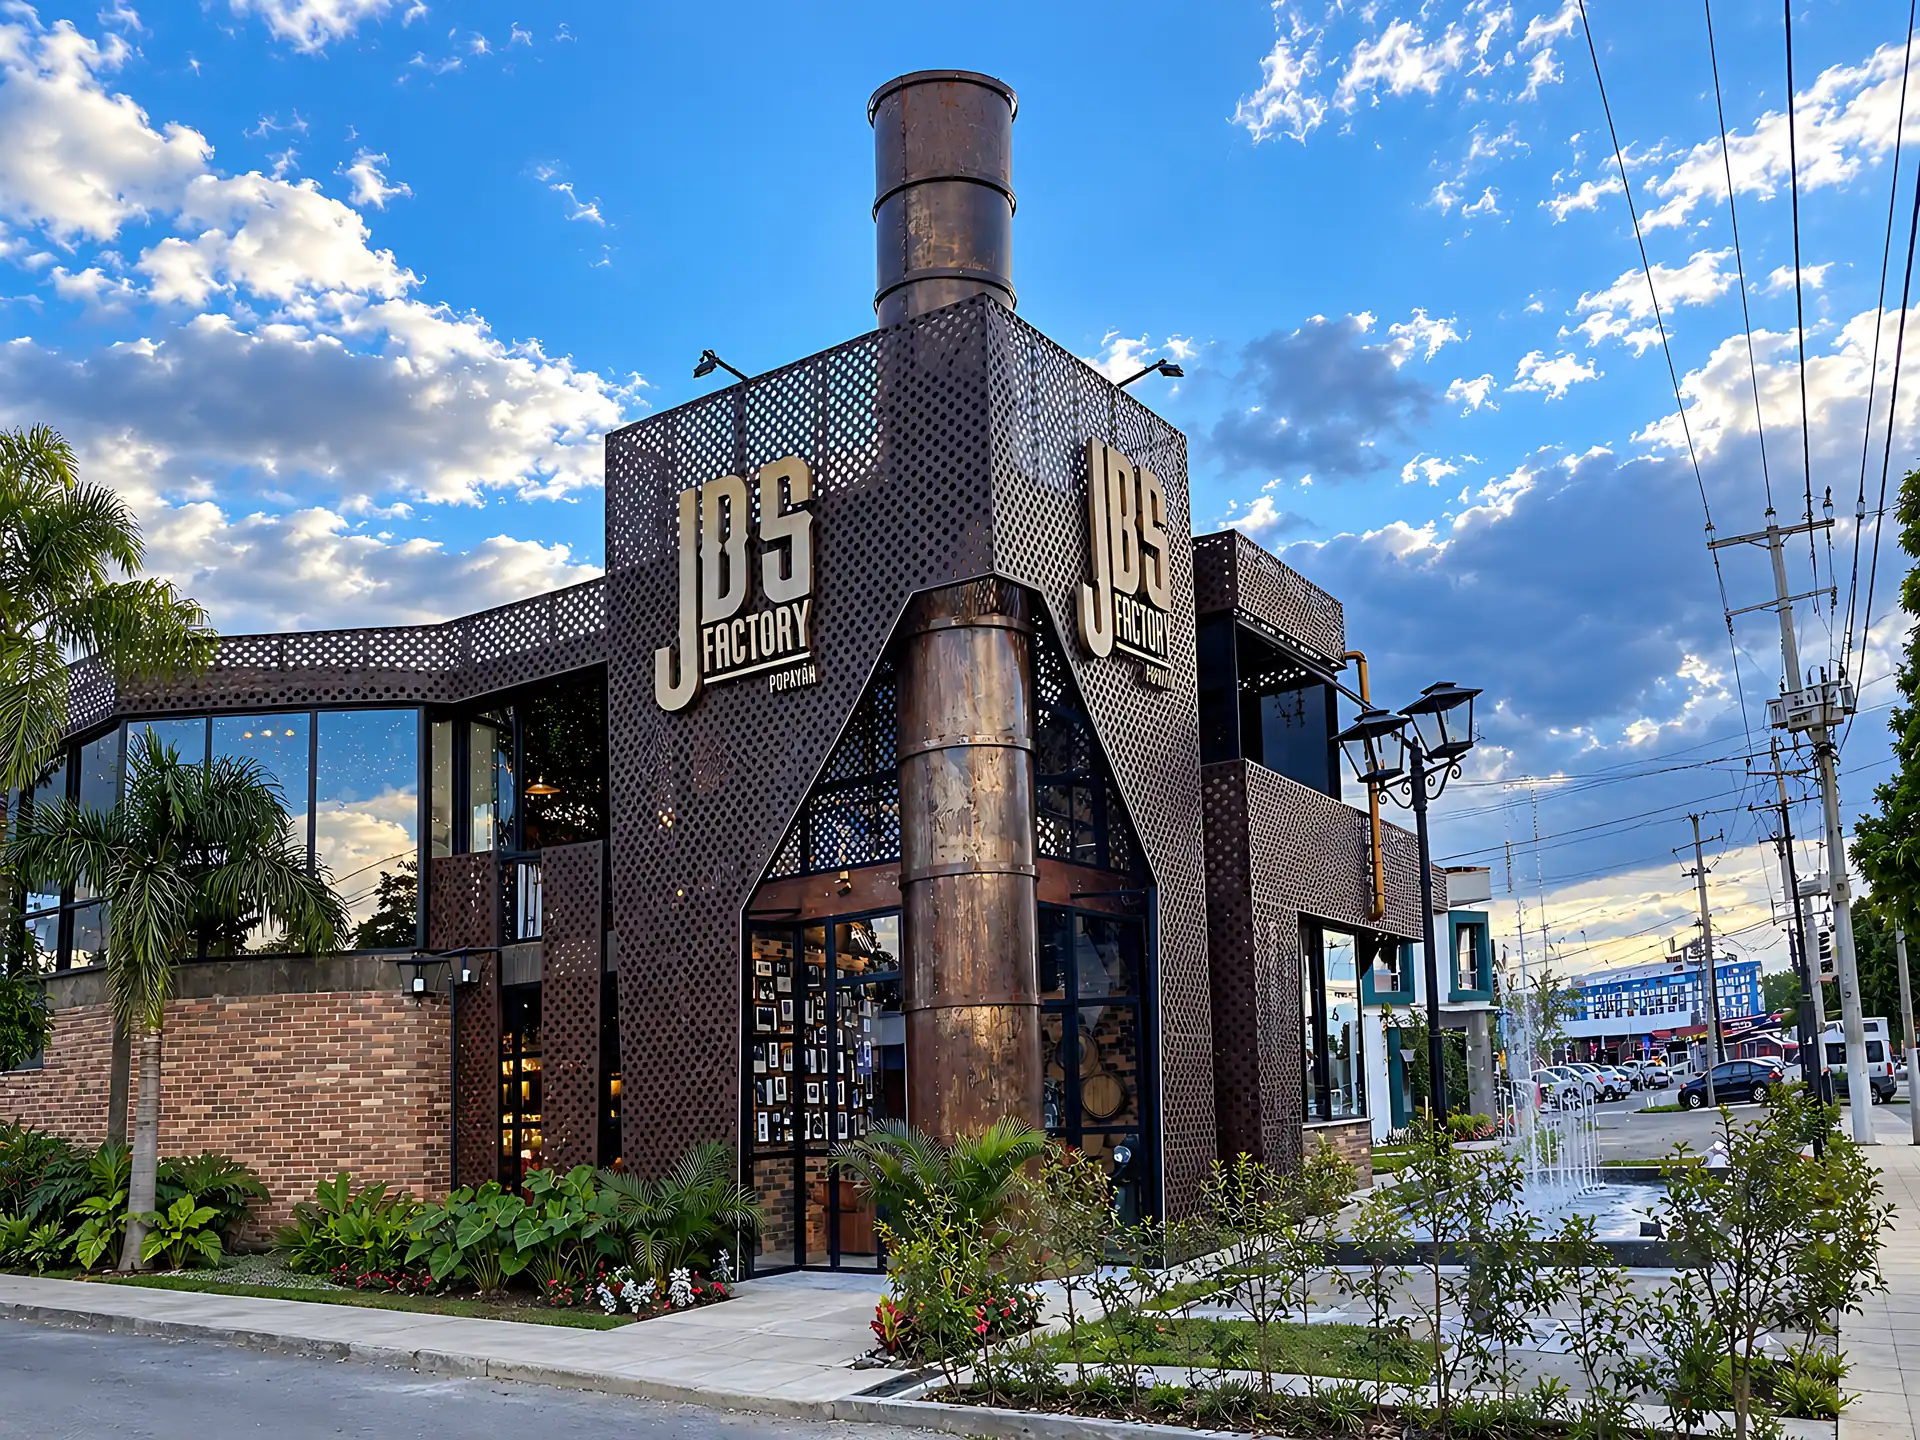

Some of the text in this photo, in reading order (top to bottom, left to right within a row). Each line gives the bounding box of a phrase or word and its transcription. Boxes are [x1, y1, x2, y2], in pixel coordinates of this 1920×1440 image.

[655, 455, 813, 711] JBS
[1080, 435, 1171, 658] JBS
[703, 600, 810, 673] FACTORY
[1115, 593, 1171, 659] FACTORY
